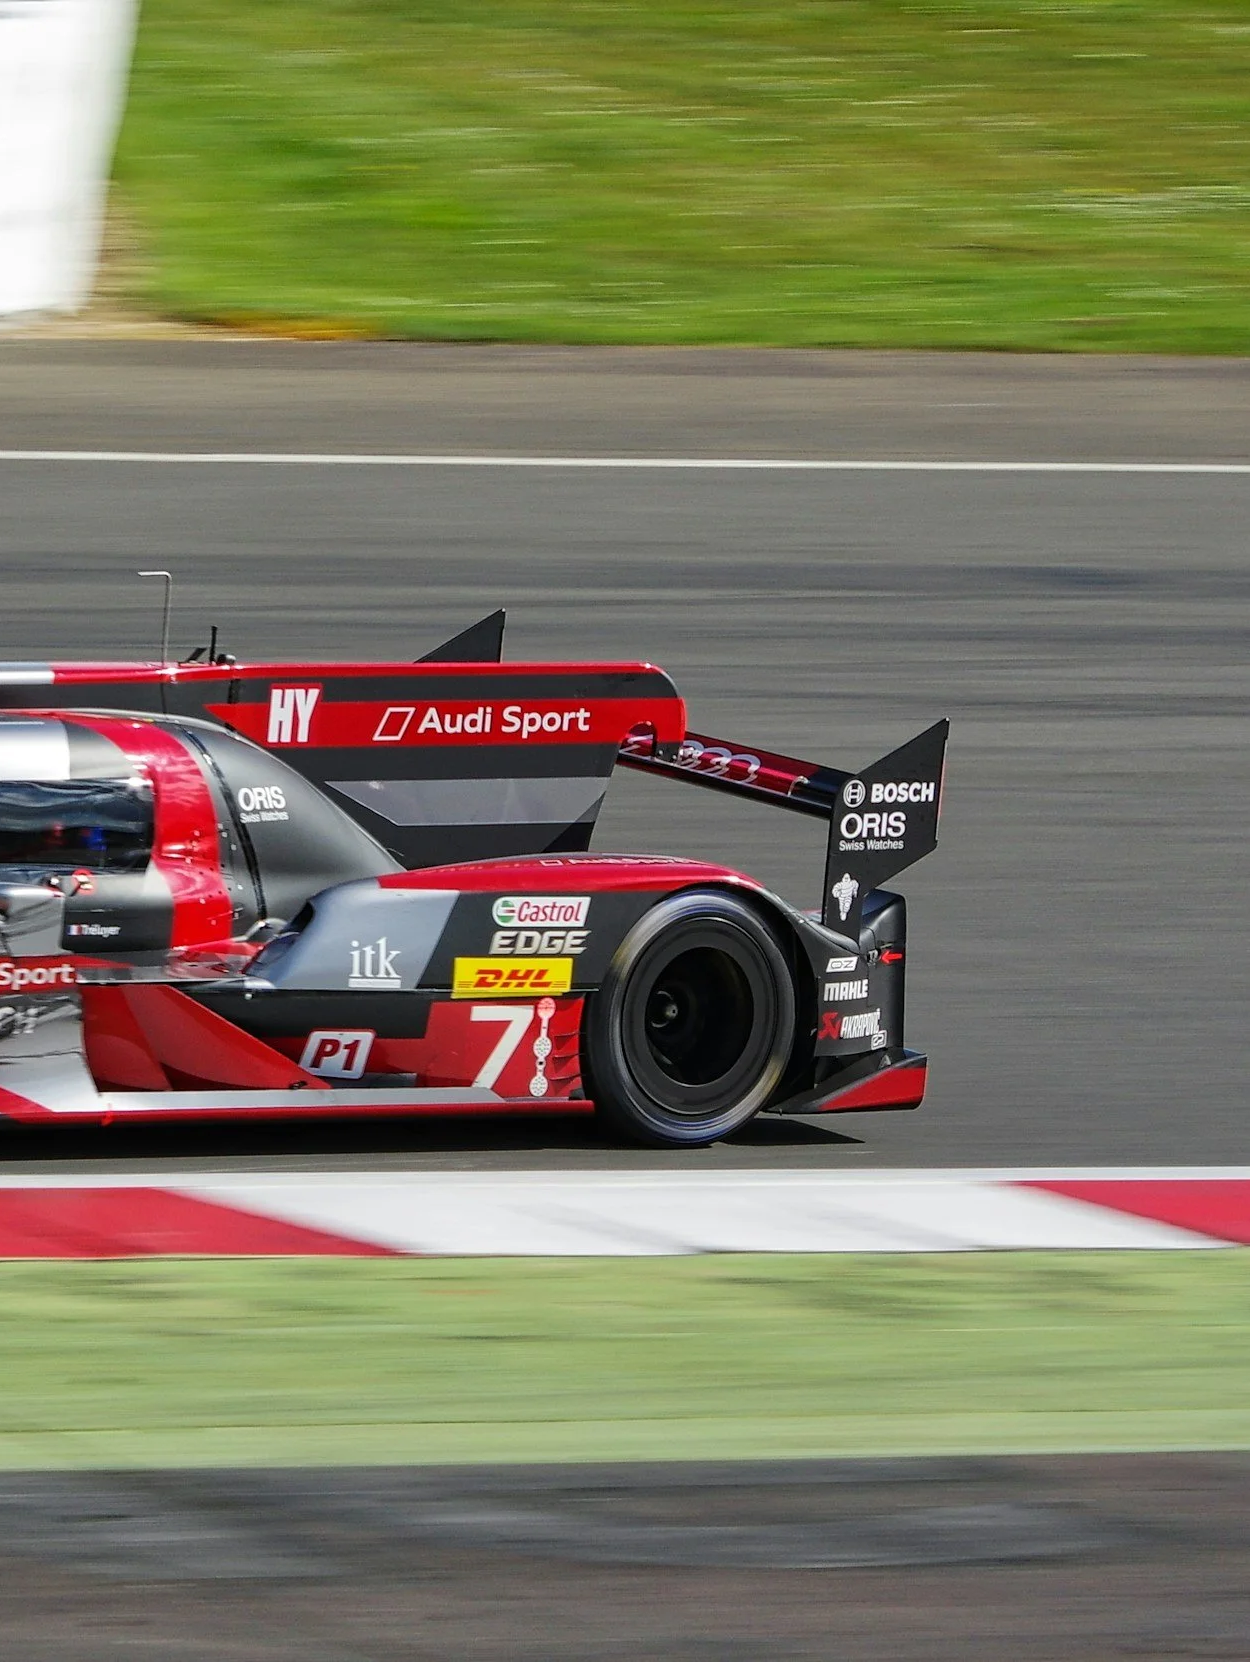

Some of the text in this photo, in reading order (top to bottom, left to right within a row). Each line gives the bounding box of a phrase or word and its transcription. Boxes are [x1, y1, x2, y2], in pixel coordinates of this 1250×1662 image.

[267, 688, 321, 743] HY
[417, 705, 591, 739] Audi Sport
[238, 786, 286, 812] ORIS
[870, 782, 935, 804] BOSCH
[840, 811, 907, 839] ORIS
[839, 838, 904, 851] Swiss Watches
[517, 901, 582, 922] Castrol
[488, 930, 592, 955] EDGE
[349, 937, 402, 978] itk
[473, 969, 552, 988] DHL
[824, 979, 869, 1001] MAHLE
[309, 1038, 362, 1071] P1
[470, 1005, 535, 1090] 7
